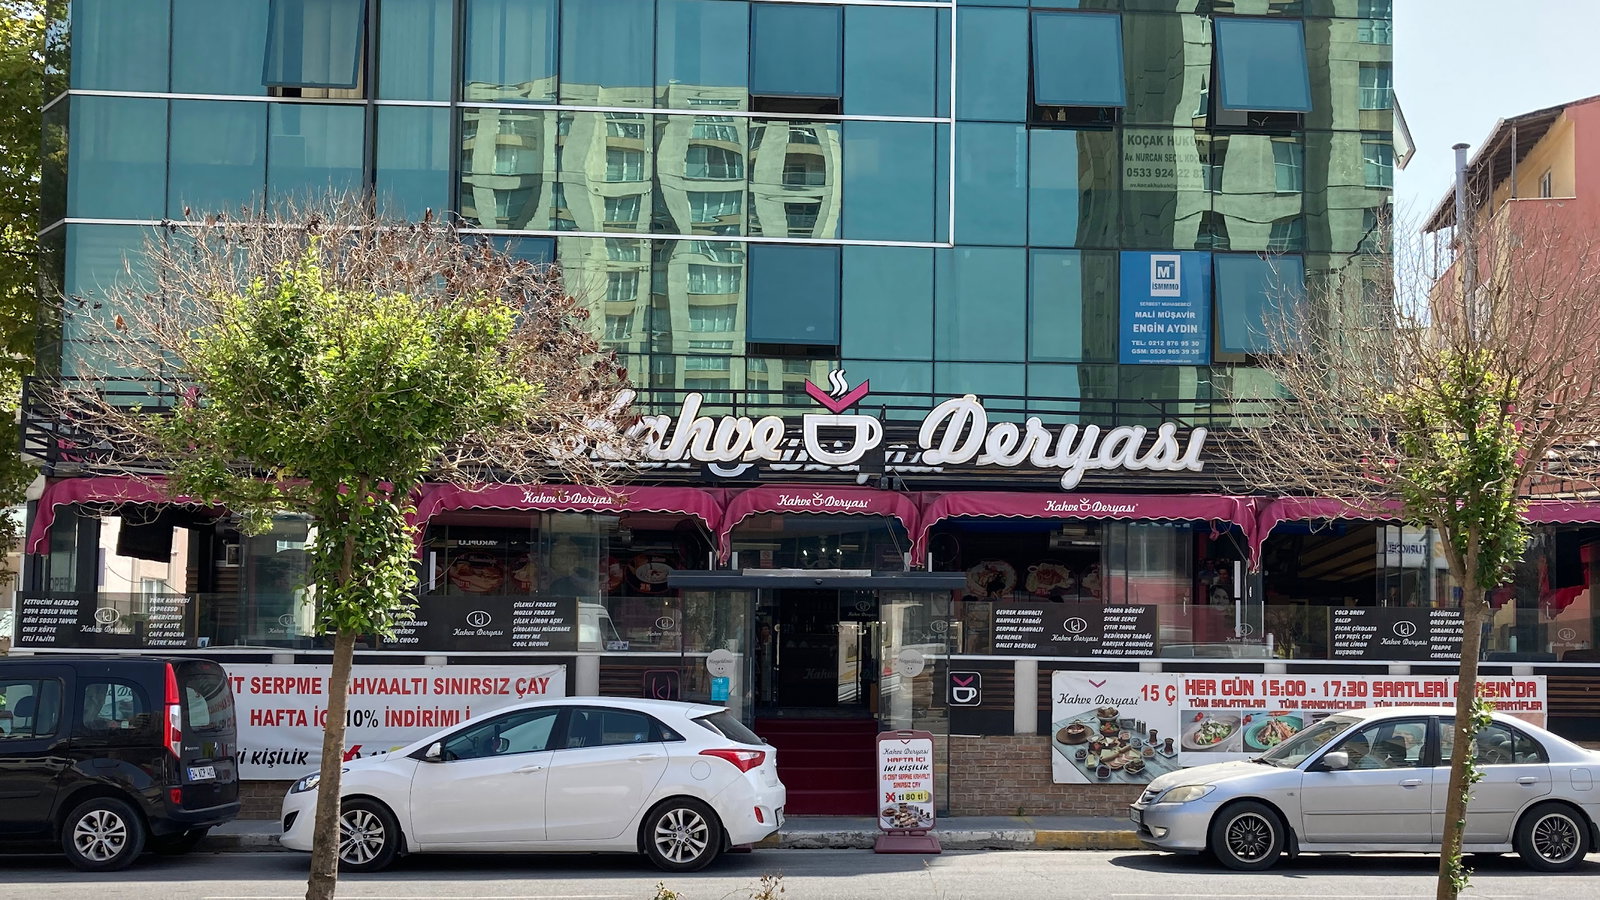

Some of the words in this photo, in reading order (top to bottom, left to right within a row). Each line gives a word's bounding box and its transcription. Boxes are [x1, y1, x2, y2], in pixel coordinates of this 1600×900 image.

[1127, 134, 1164, 148] KOÇAK
[1167, 135, 1205, 146] HUKUK
[1136, 154, 1163, 162] NURCAN
[1126, 168, 1152, 178] 0533
[1154, 168, 1174, 178] 924
[1178, 168, 1188, 178] 22
[1158, 310, 1196, 319] MÜŞAVİR
[1133, 322, 1164, 333] ENGİN
[1166, 324, 1198, 334] AYDIN
[918, 394, 1208, 490] Deryası
[776, 494, 813, 507] Kahve
[824, 495, 869, 510] Deryası
[1044, 500, 1080, 512] Kahve
[1090, 500, 1136, 514] Deryası
[453, 628, 475, 636] Kahve
[477, 628, 504, 637] Deryası
[1051, 634, 1071, 642] Kahve
[1074, 634, 1098, 643] Deryası
[1402, 638, 1427, 647] Deryası
[250, 677, 322, 694] SERPME
[433, 678, 510, 695] SINIRSIZ
[515, 677, 550, 699] ÇAY
[1141, 684, 1160, 701] 15
[1185, 680, 1216, 696] HER
[1222, 676, 1254, 696] GÜN
[1261, 680, 1306, 696] 15:00
[1323, 680, 1368, 697] 17:30
[1372, 678, 1449, 698] SAATLERİ
[1057, 693, 1092, 705] Kahve
[1094, 694, 1139, 706] Deryası
[1189, 698, 1209, 707] TÜM
[1211, 698, 1266, 708] SALATALAR
[1279, 698, 1298, 709] TÜM
[1301, 699, 1366, 709] SANDWİCHLER
[250, 709, 308, 726] HAFTA
[250, 748, 309, 768] KİŞİLİK
